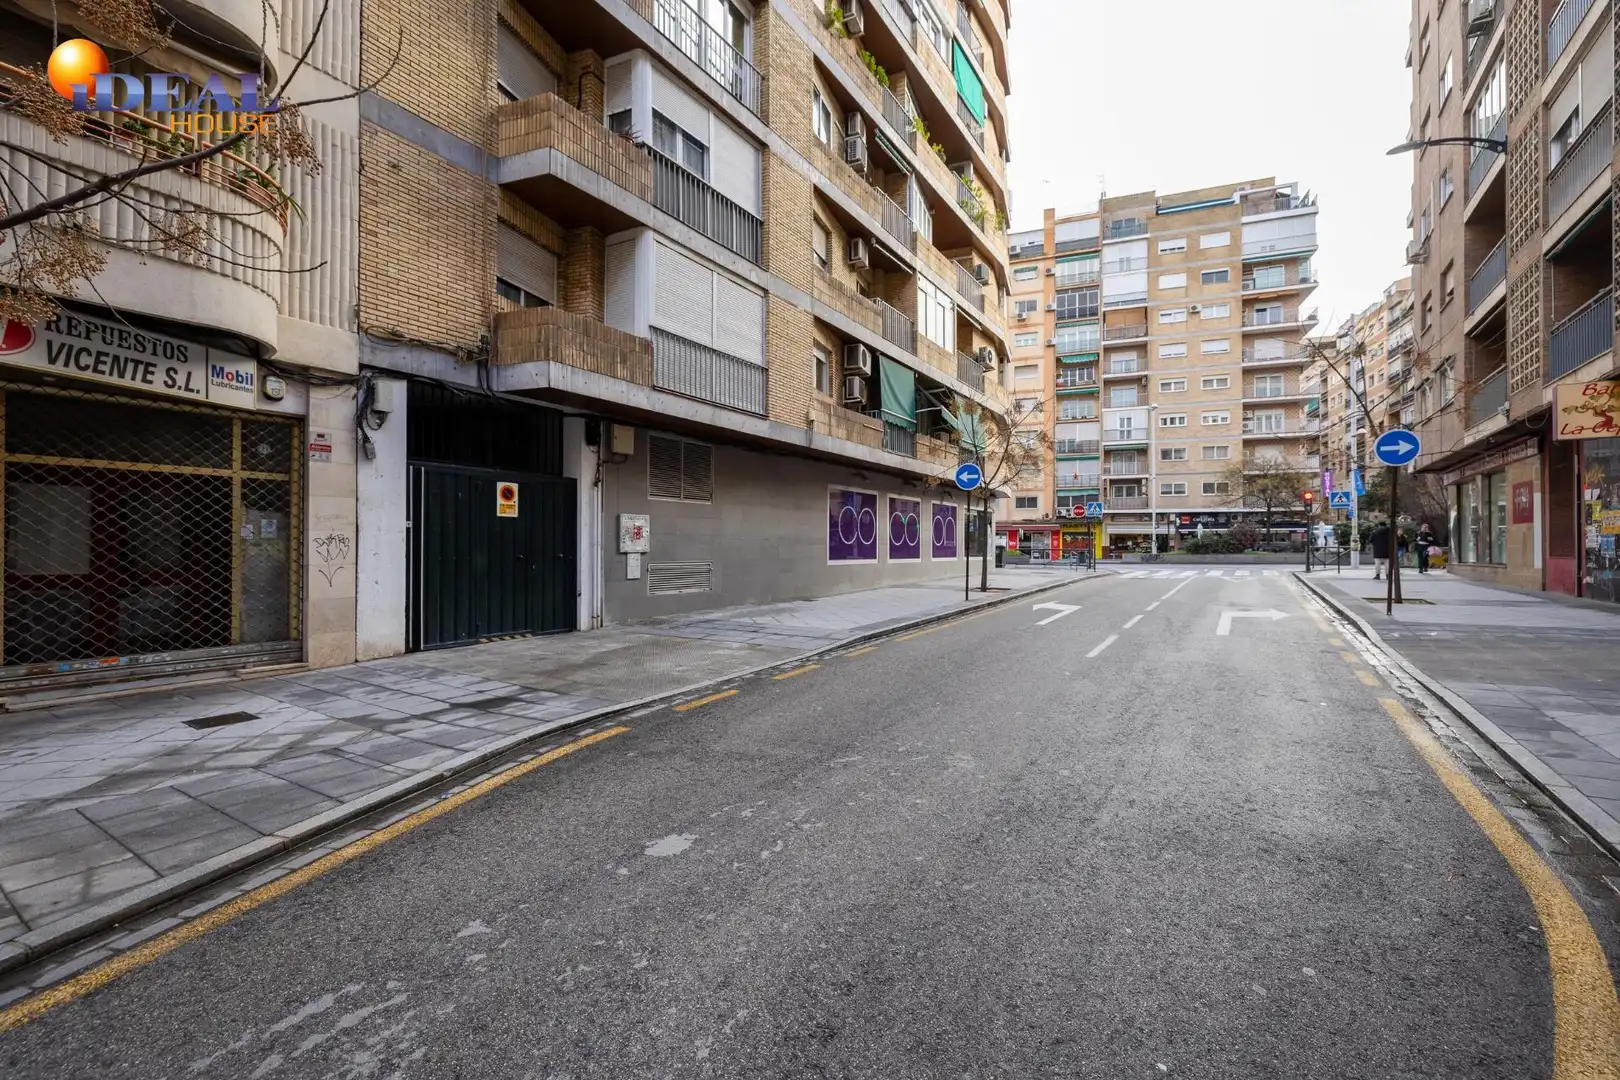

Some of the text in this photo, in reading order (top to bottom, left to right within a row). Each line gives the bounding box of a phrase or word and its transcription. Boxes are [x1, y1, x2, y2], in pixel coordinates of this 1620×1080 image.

[44, 311, 189, 364] REPUESTOS
[46, 339, 200, 394] VICENTE S.L.
[211, 364, 254, 386] Mobil
[211, 379, 254, 394] Lubricantes
